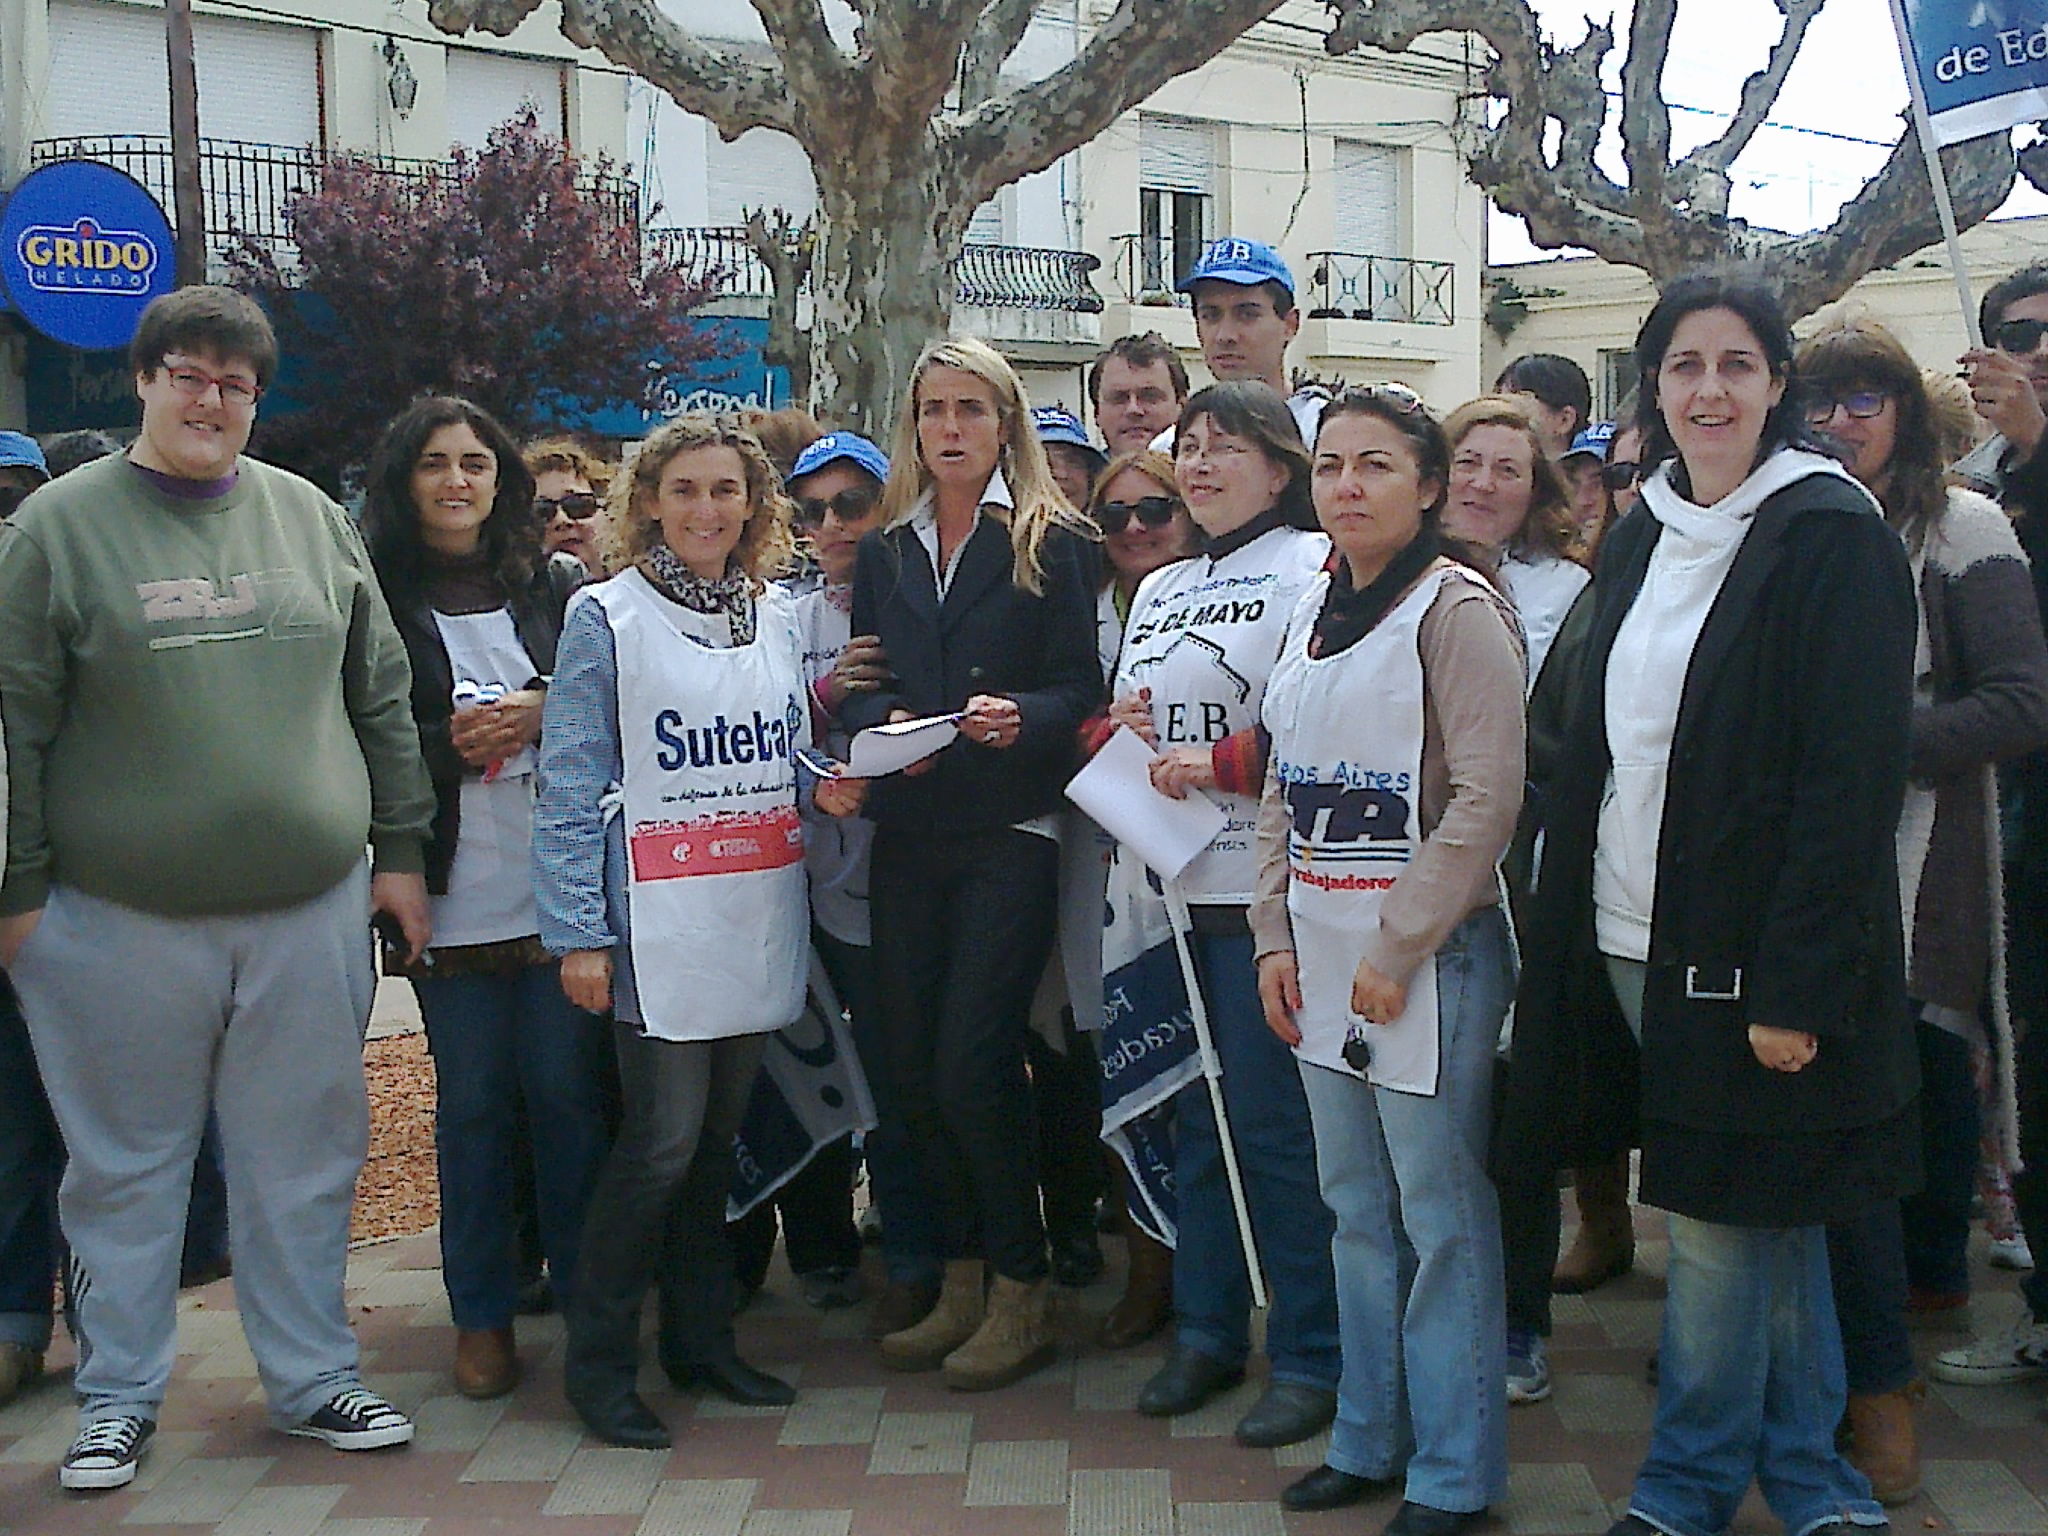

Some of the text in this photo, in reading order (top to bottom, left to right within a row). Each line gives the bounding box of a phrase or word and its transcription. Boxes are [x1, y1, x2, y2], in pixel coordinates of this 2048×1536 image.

[1935, 46, 1991, 82] de
[26, 236, 149, 271] GRIDO
[36, 271, 142, 286] HELADO
[1189, 599, 1265, 627] MAYO
[1149, 702, 1230, 743] .E.B
[655, 708, 787, 771] Suteba
[1333, 760, 1411, 792] Aires
[1290, 865, 1397, 892] rabajadore
